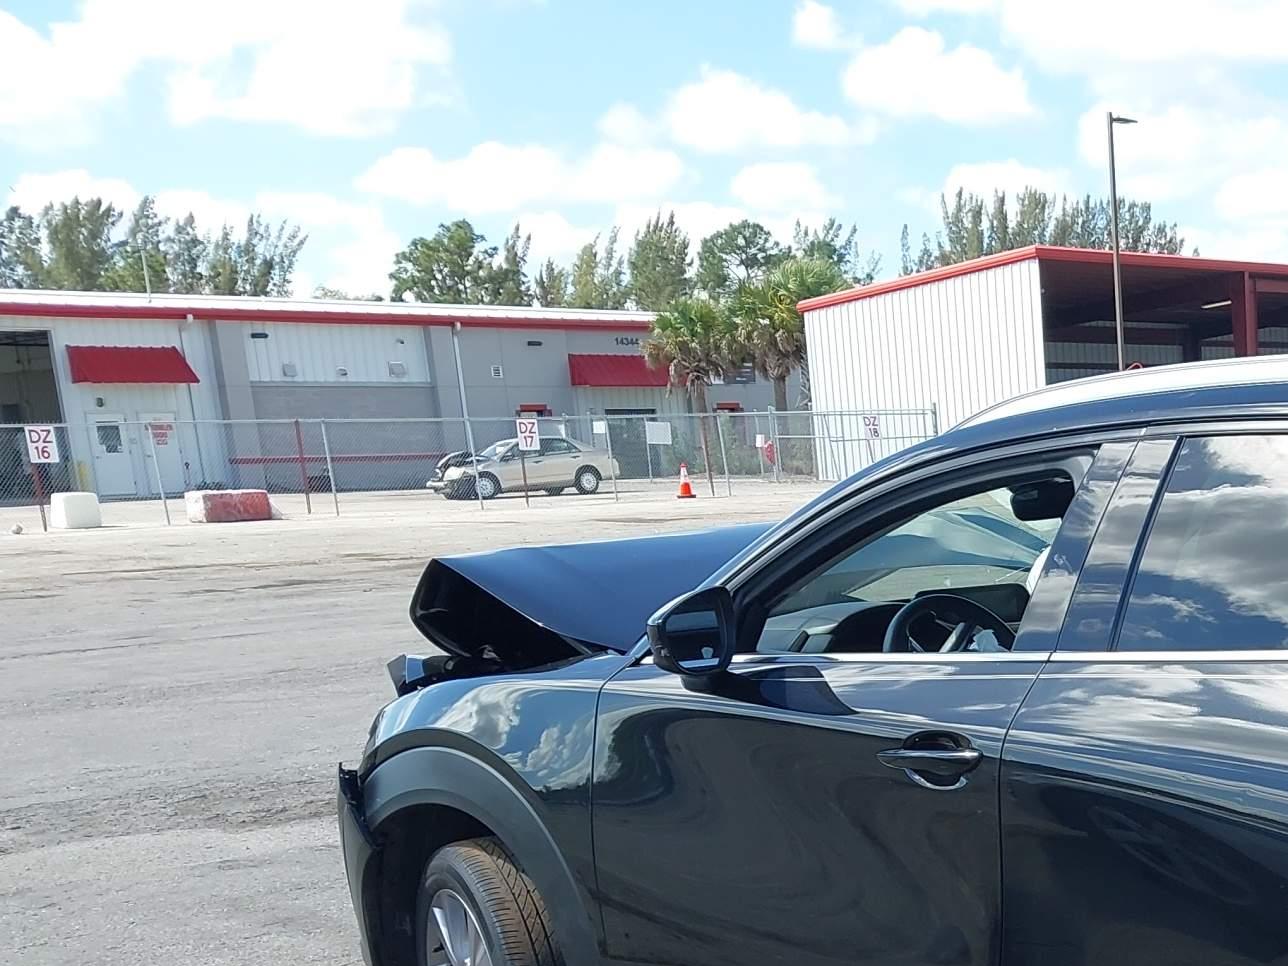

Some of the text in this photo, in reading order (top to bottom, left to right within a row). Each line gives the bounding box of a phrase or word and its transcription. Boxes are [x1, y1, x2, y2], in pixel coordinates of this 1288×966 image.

[518, 421, 537, 434] DZ
[863, 415, 879, 427] DZ
[28, 429, 54, 444] DZ
[868, 427, 880, 439] 18
[523, 435, 534, 448] 17
[34, 445, 51, 460] 16
